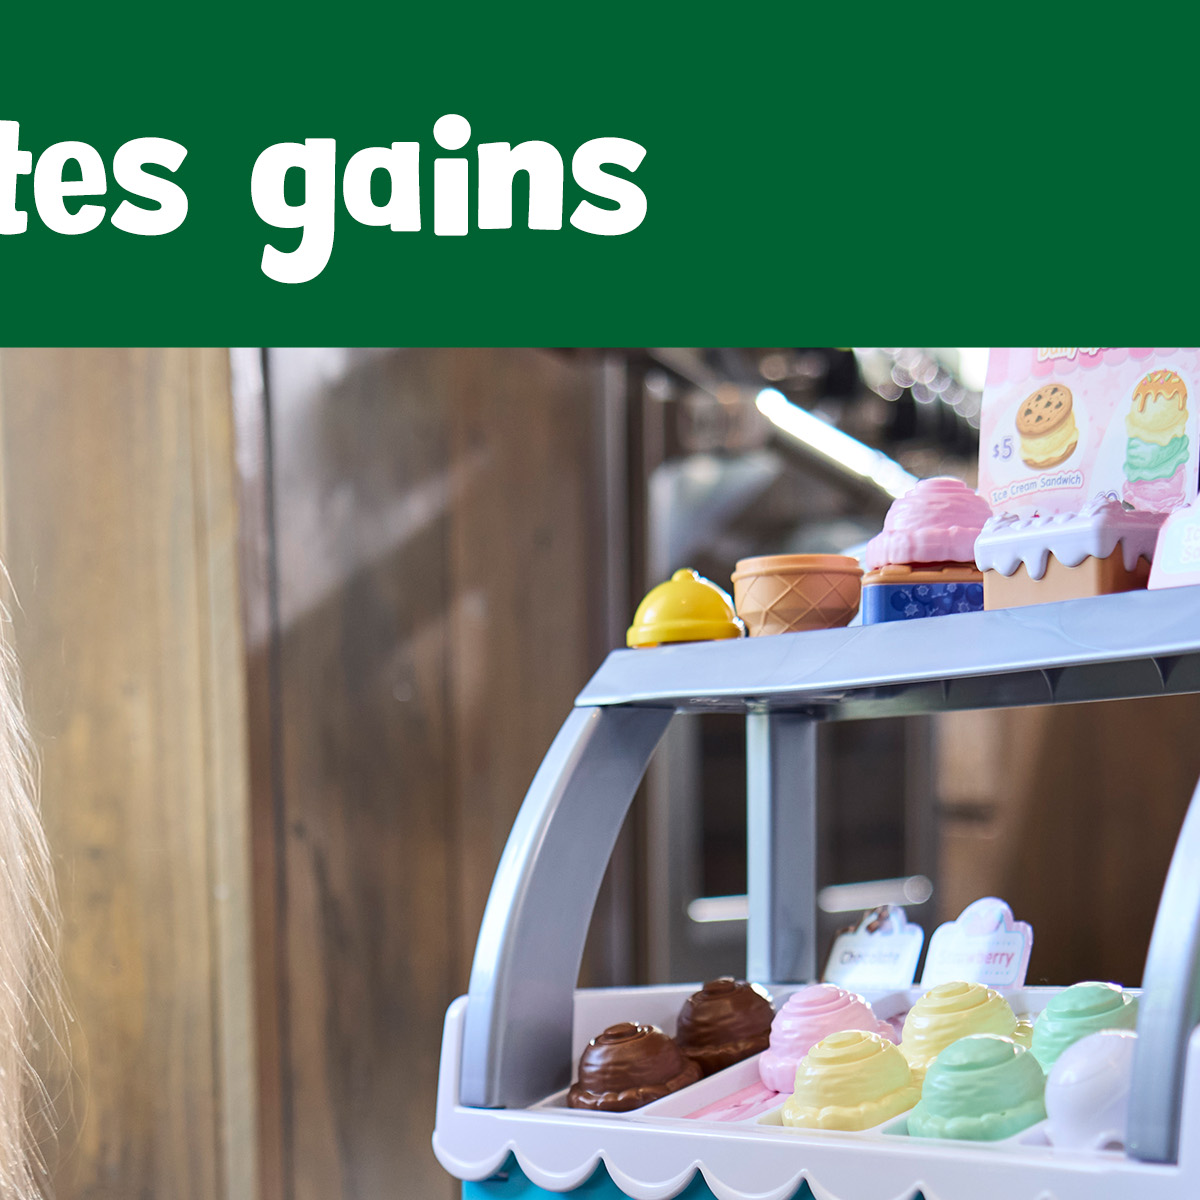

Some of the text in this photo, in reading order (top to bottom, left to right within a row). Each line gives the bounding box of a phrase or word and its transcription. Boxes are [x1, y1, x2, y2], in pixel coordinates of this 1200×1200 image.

[992, 438, 1012, 459] $5
[993, 474, 1081, 502] Ice Cream Sandwich
